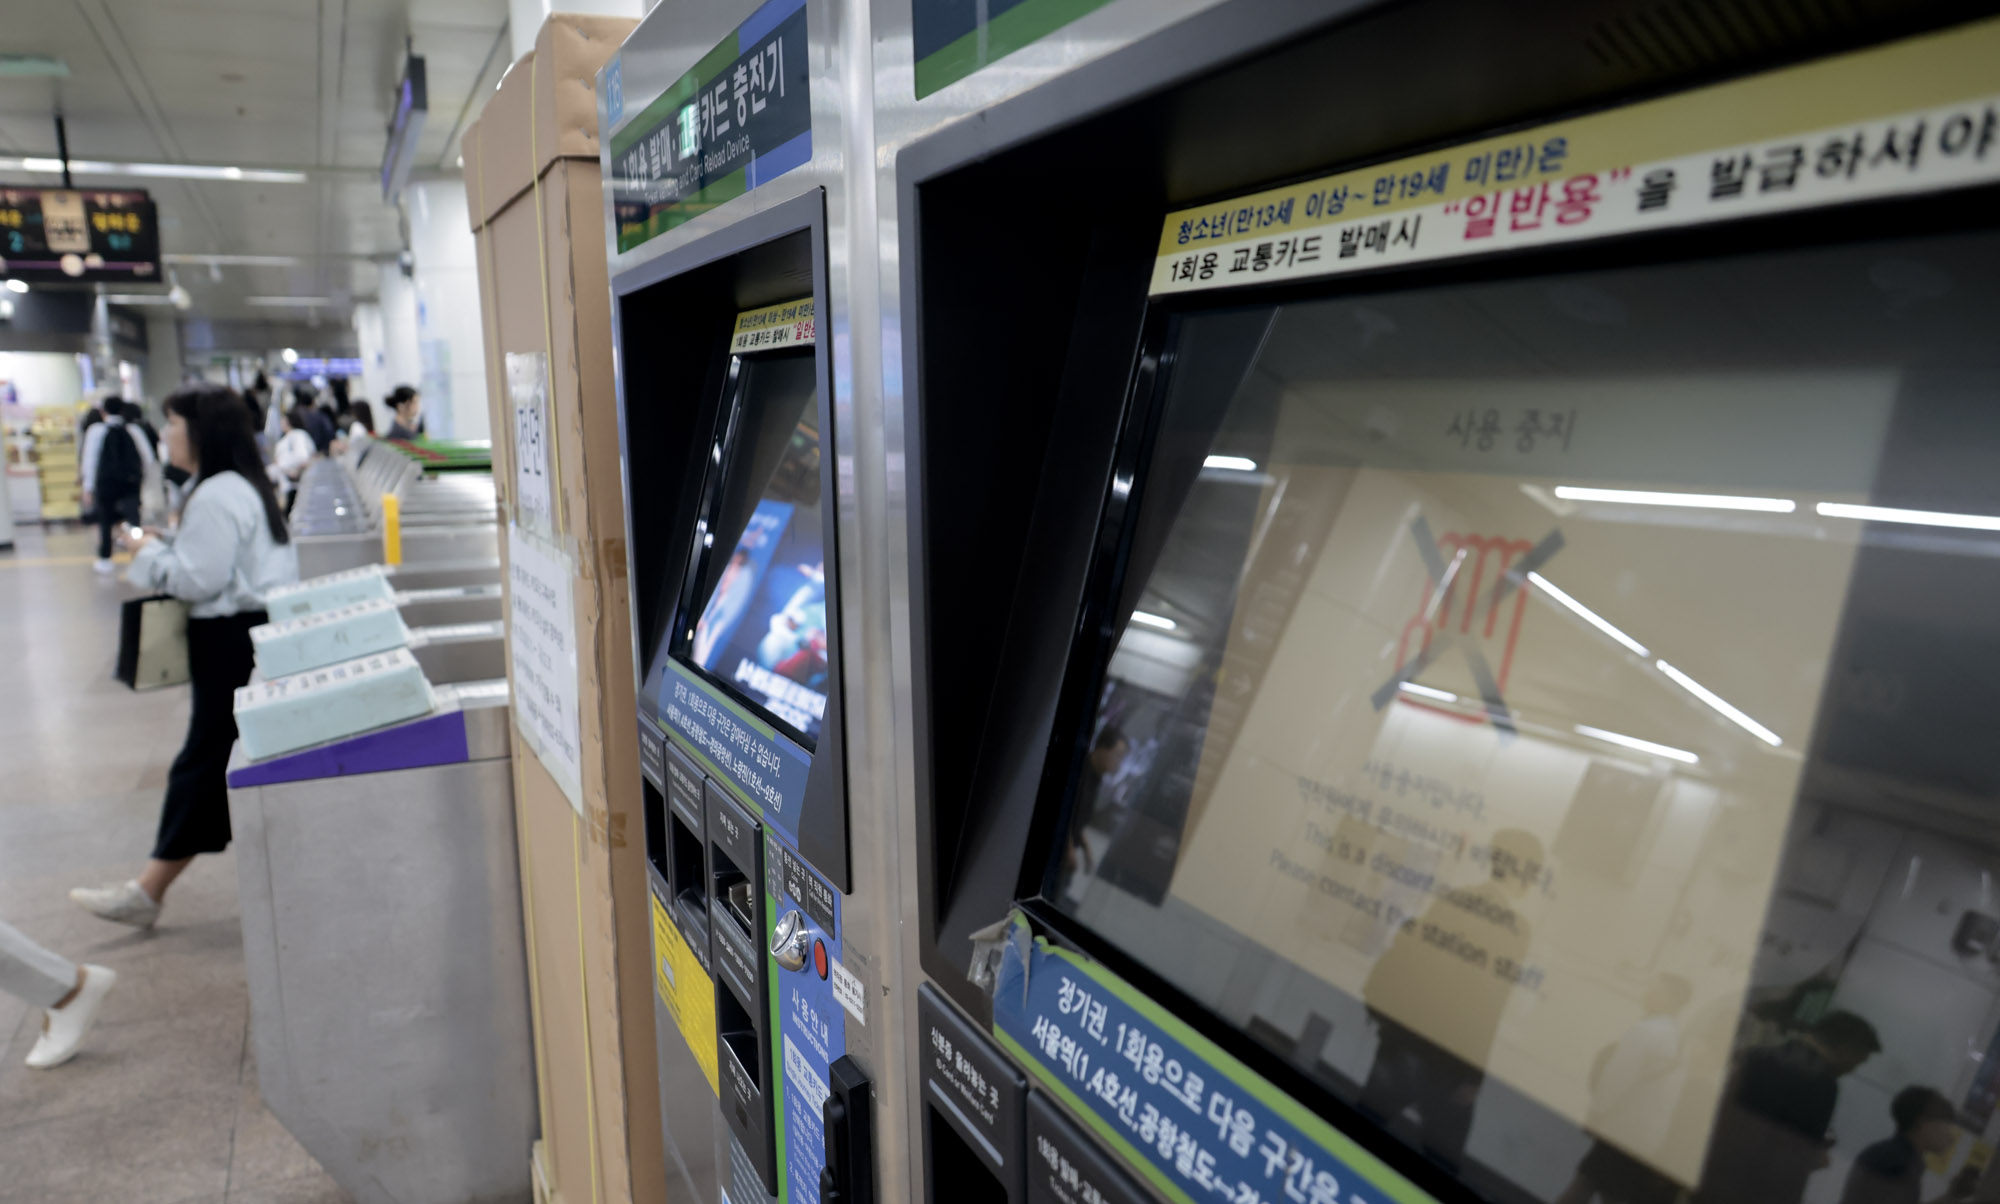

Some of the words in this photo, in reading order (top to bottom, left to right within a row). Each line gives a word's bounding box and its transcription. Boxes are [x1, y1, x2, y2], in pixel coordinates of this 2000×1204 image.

[623, 141, 648, 197] 1회용
[733, 36, 785, 128] 충전기
[690, 157, 703, 183] Card
[703, 144, 726, 174] Reload
[726, 133, 750, 161] Device
[1178, 197, 1295, 245] 청소년(만13세
[1464, 137, 1568, 186] 미만)은
[1171, 251, 1219, 282] 1회용
[1229, 236, 1322, 272] 교통카드
[1339, 214, 1422, 259] 발매시
[1446, 406, 1503, 453] 사용
[1515, 405, 1578, 454] 중지
[688, 692, 708, 717] 1회용으로
[707, 705, 718, 727] 다음
[716, 712, 731, 738] 구간은
[729, 722, 752, 755] 갈아타실
[750, 738, 757, 758] 수
[756, 743, 781, 778] 없습니다.
[1305, 821, 1333, 854] This
[1353, 847, 1367, 866] a
[800, 867, 806, 881] 곳
[1270, 848, 1317, 888] Please
[1317, 875, 1384, 921] contact
[1386, 904, 1418, 933] the
[1421, 922, 1489, 969] station
[792, 1011, 829, 1064] INSTRUCTIONS
[803, 1066, 824, 1102] 교통카드
[931, 1027, 953, 1061] 신분증
[990, 1086, 999, 1109] 곳
[1115, 1022, 1205, 1115] 1회용으로
[1207, 1091, 1257, 1159] 다음
[1037, 1135, 1059, 1172] 1회용
